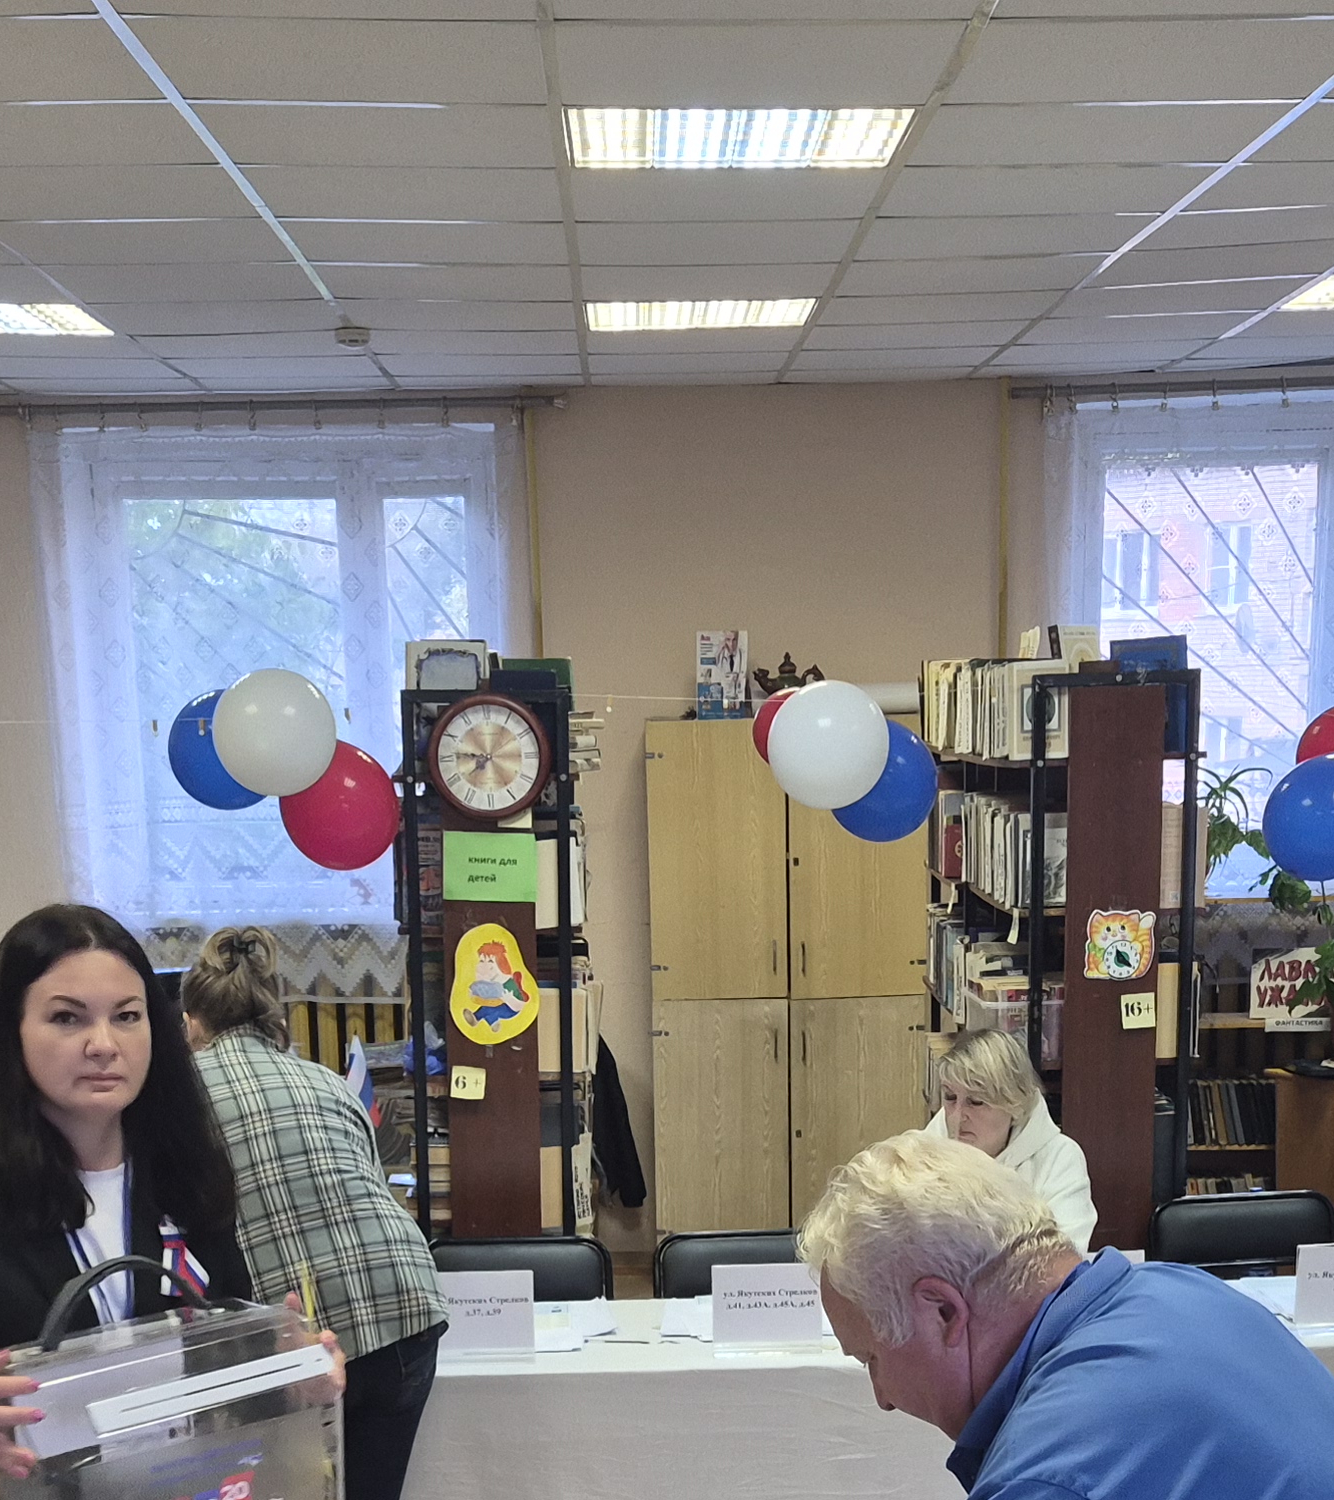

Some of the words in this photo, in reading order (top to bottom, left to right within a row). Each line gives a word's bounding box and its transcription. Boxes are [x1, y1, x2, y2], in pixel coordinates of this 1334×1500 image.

[468, 857, 497, 866] книги
[499, 858, 518, 867] для
[468, 874, 497, 883] детей
[1124, 1001, 1153, 1017] 16+
[1308, 1272, 1320, 1280] ул.
[723, 1291, 736, 1300] ул.
[737, 1289, 776, 1299] Якутских
[778, 1288, 818, 1298] Стрелков
[448, 1297, 488, 1306] Якутских
[489, 1296, 529, 1305] Стрелков
[798, 1300, 816, 1309] д.45
